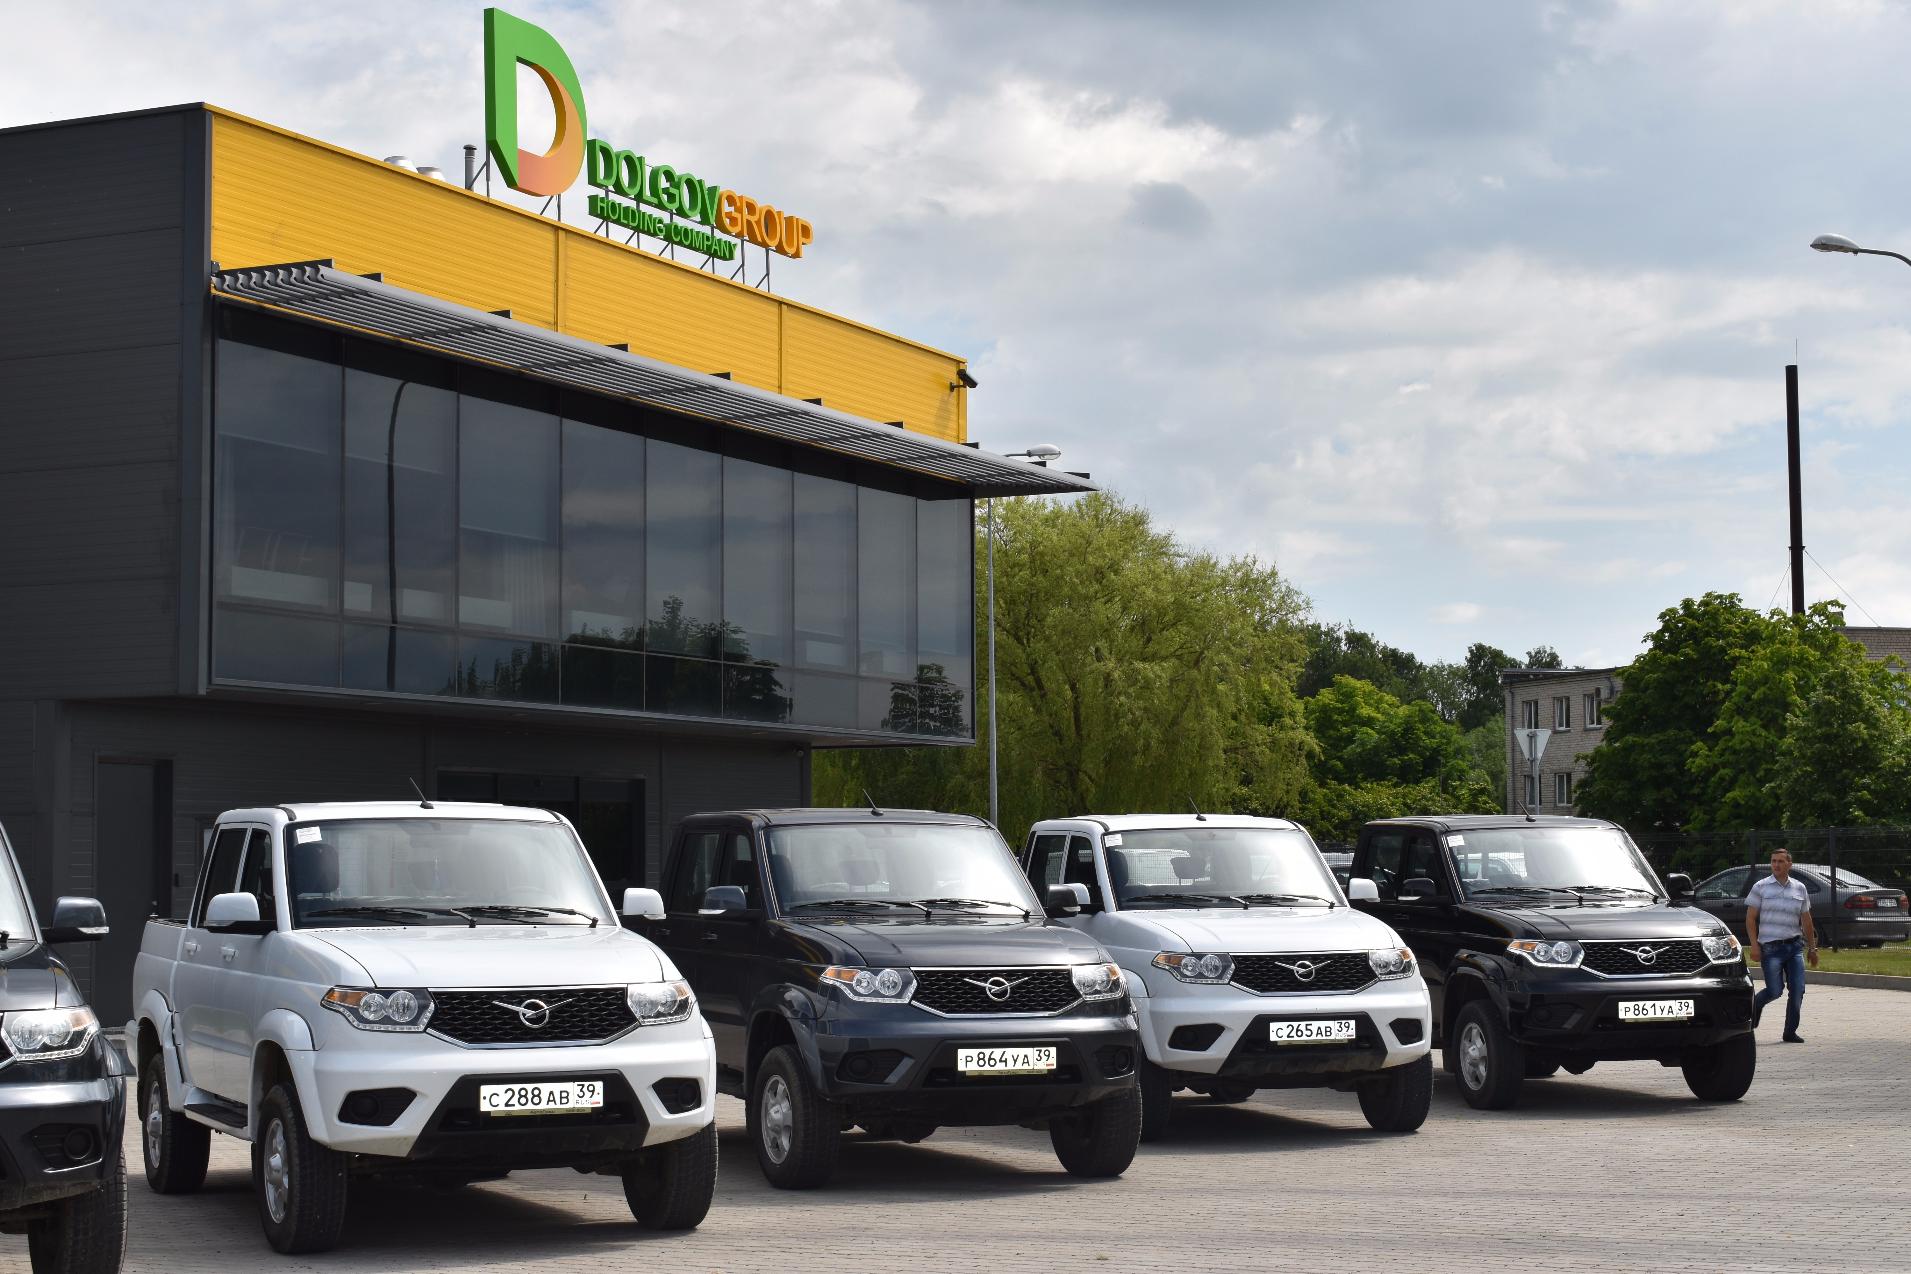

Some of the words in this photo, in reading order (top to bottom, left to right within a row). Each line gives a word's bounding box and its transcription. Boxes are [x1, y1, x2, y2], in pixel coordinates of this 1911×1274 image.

[588, 194, 666, 237] HOLDING
[663, 222, 738, 261] COMPANY
[1677, 1001, 1690, 1012] 39
[1336, 1021, 1351, 1033] 39
[1035, 1048, 1051, 1062] 39
[576, 1083, 596, 1099] 39
